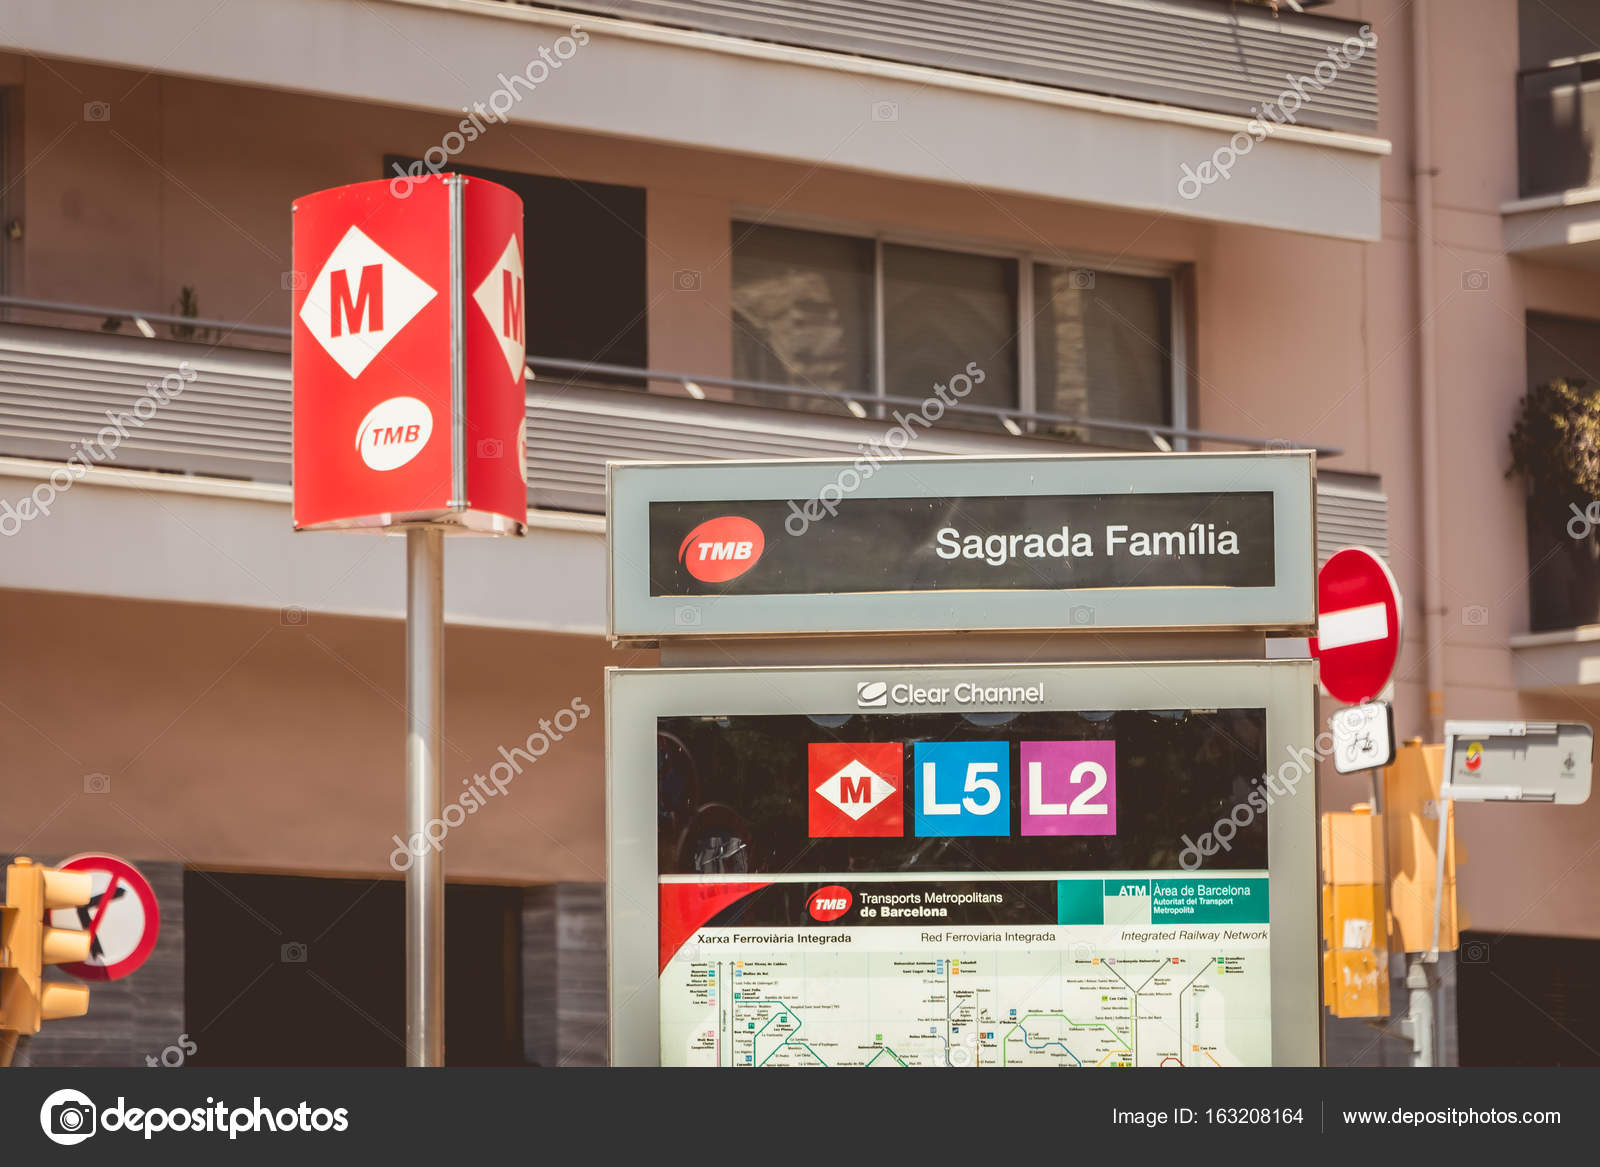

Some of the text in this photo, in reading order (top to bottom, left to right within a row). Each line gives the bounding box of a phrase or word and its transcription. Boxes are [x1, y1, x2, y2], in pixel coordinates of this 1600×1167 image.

[330, 264, 384, 338] M
[373, 425, 420, 447] TMB
[698, 541, 752, 561] TMB
[936, 523, 1239, 566] Sagrada Família
[891, 682, 1044, 704] Clear Channel
[839, 777, 872, 803] M
[922, 762, 1001, 815] L5
[1028, 761, 1108, 815] L2
[1119, 885, 1147, 896] ATM
[1153, 882, 1251, 896] Àrea de Barcelona
[815, 898, 847, 911] TMB
[860, 892, 1003, 906] Transports Metropolitans
[1153, 897, 1234, 906] Autoritat del Transport
[860, 906, 948, 917] de Barcelona
[697, 933, 852, 945] Xarxa Ferroviària Integrada
[921, 931, 1056, 944] Red Ferroviaria Integrada
[1121, 930, 1268, 942] Integrated Railway Network
